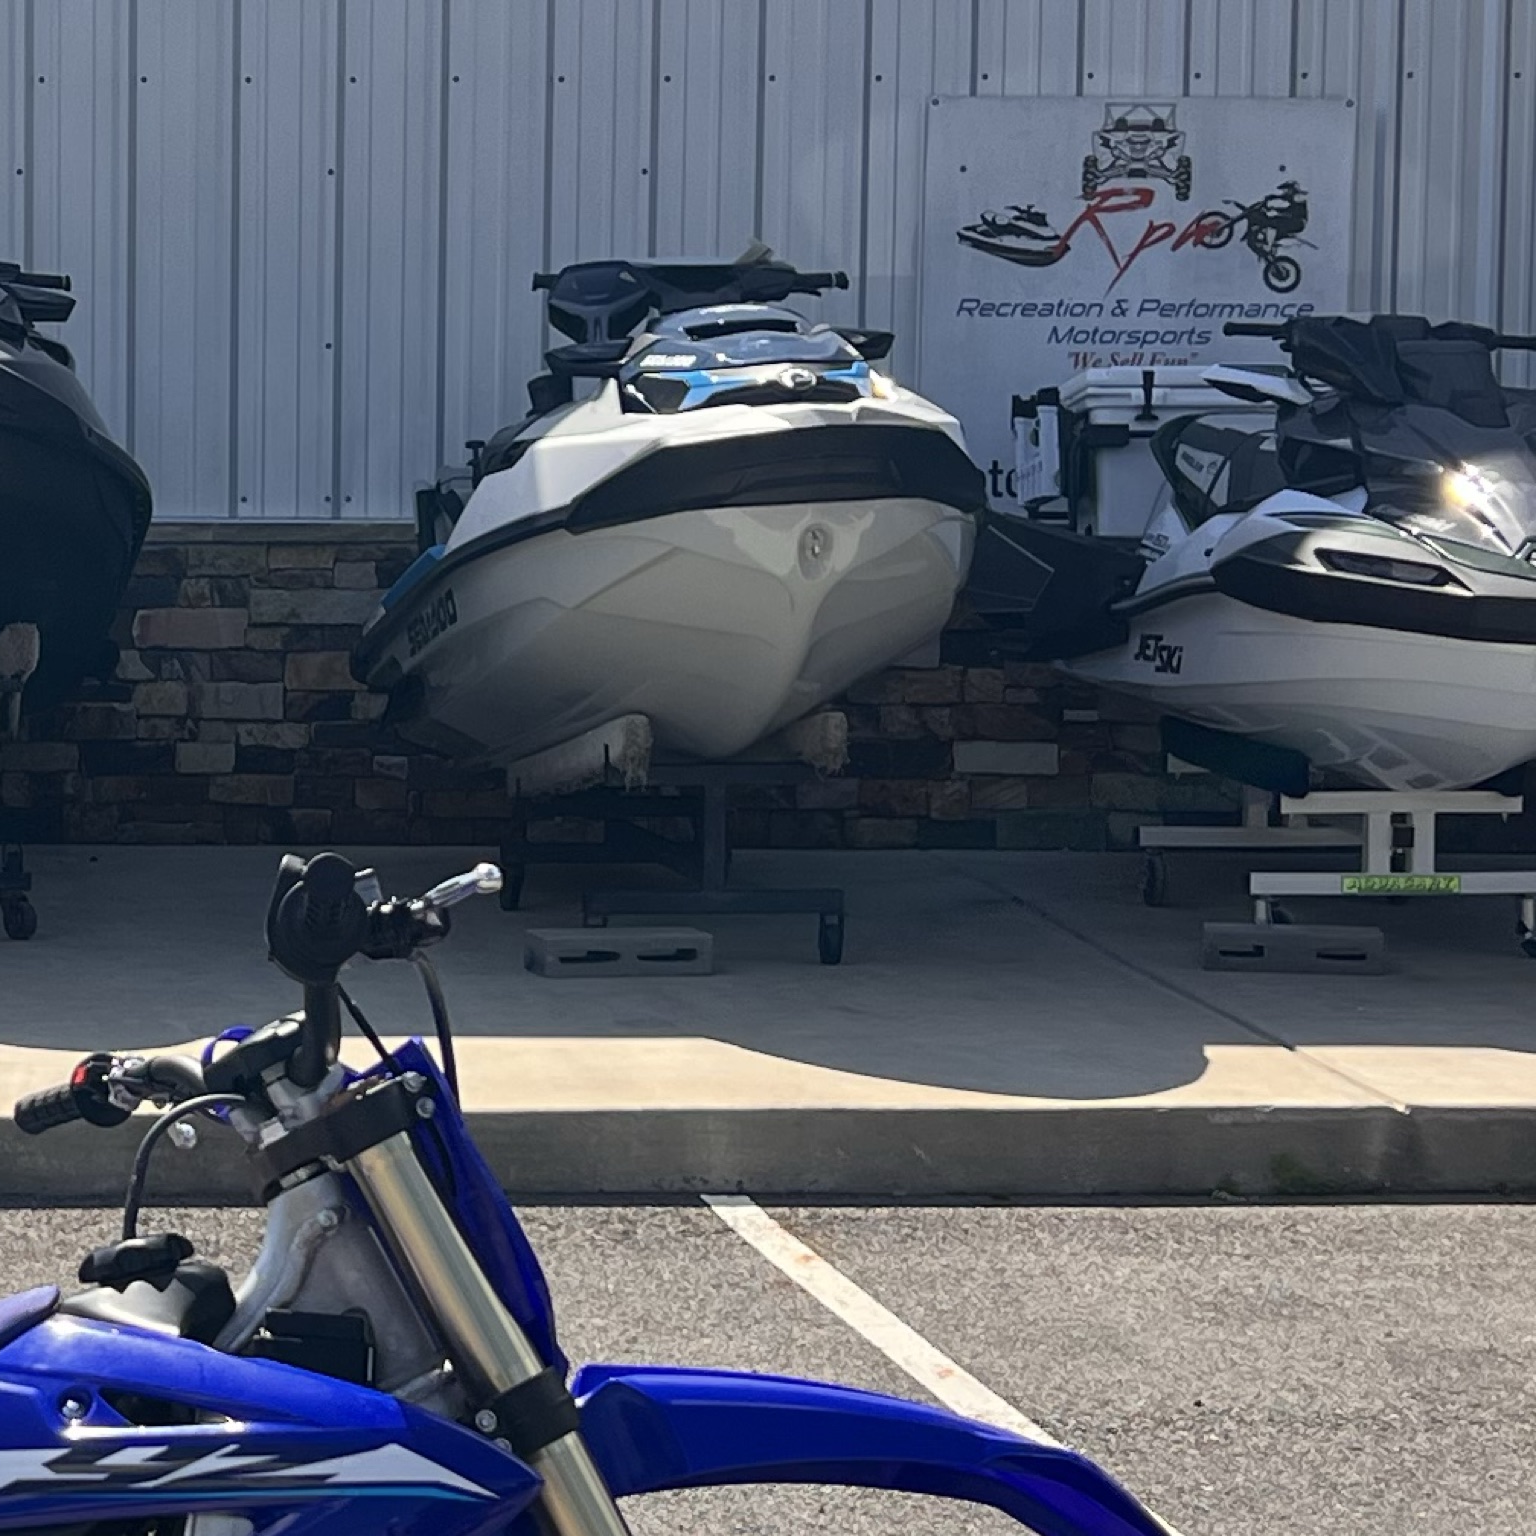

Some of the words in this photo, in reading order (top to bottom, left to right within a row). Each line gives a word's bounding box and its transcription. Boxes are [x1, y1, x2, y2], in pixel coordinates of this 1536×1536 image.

[956, 297, 1104, 318] Recreation
[1110, 298, 1130, 318] &
[1136, 297, 1314, 318] Performance
[1047, 325, 1213, 349] Motorsports
